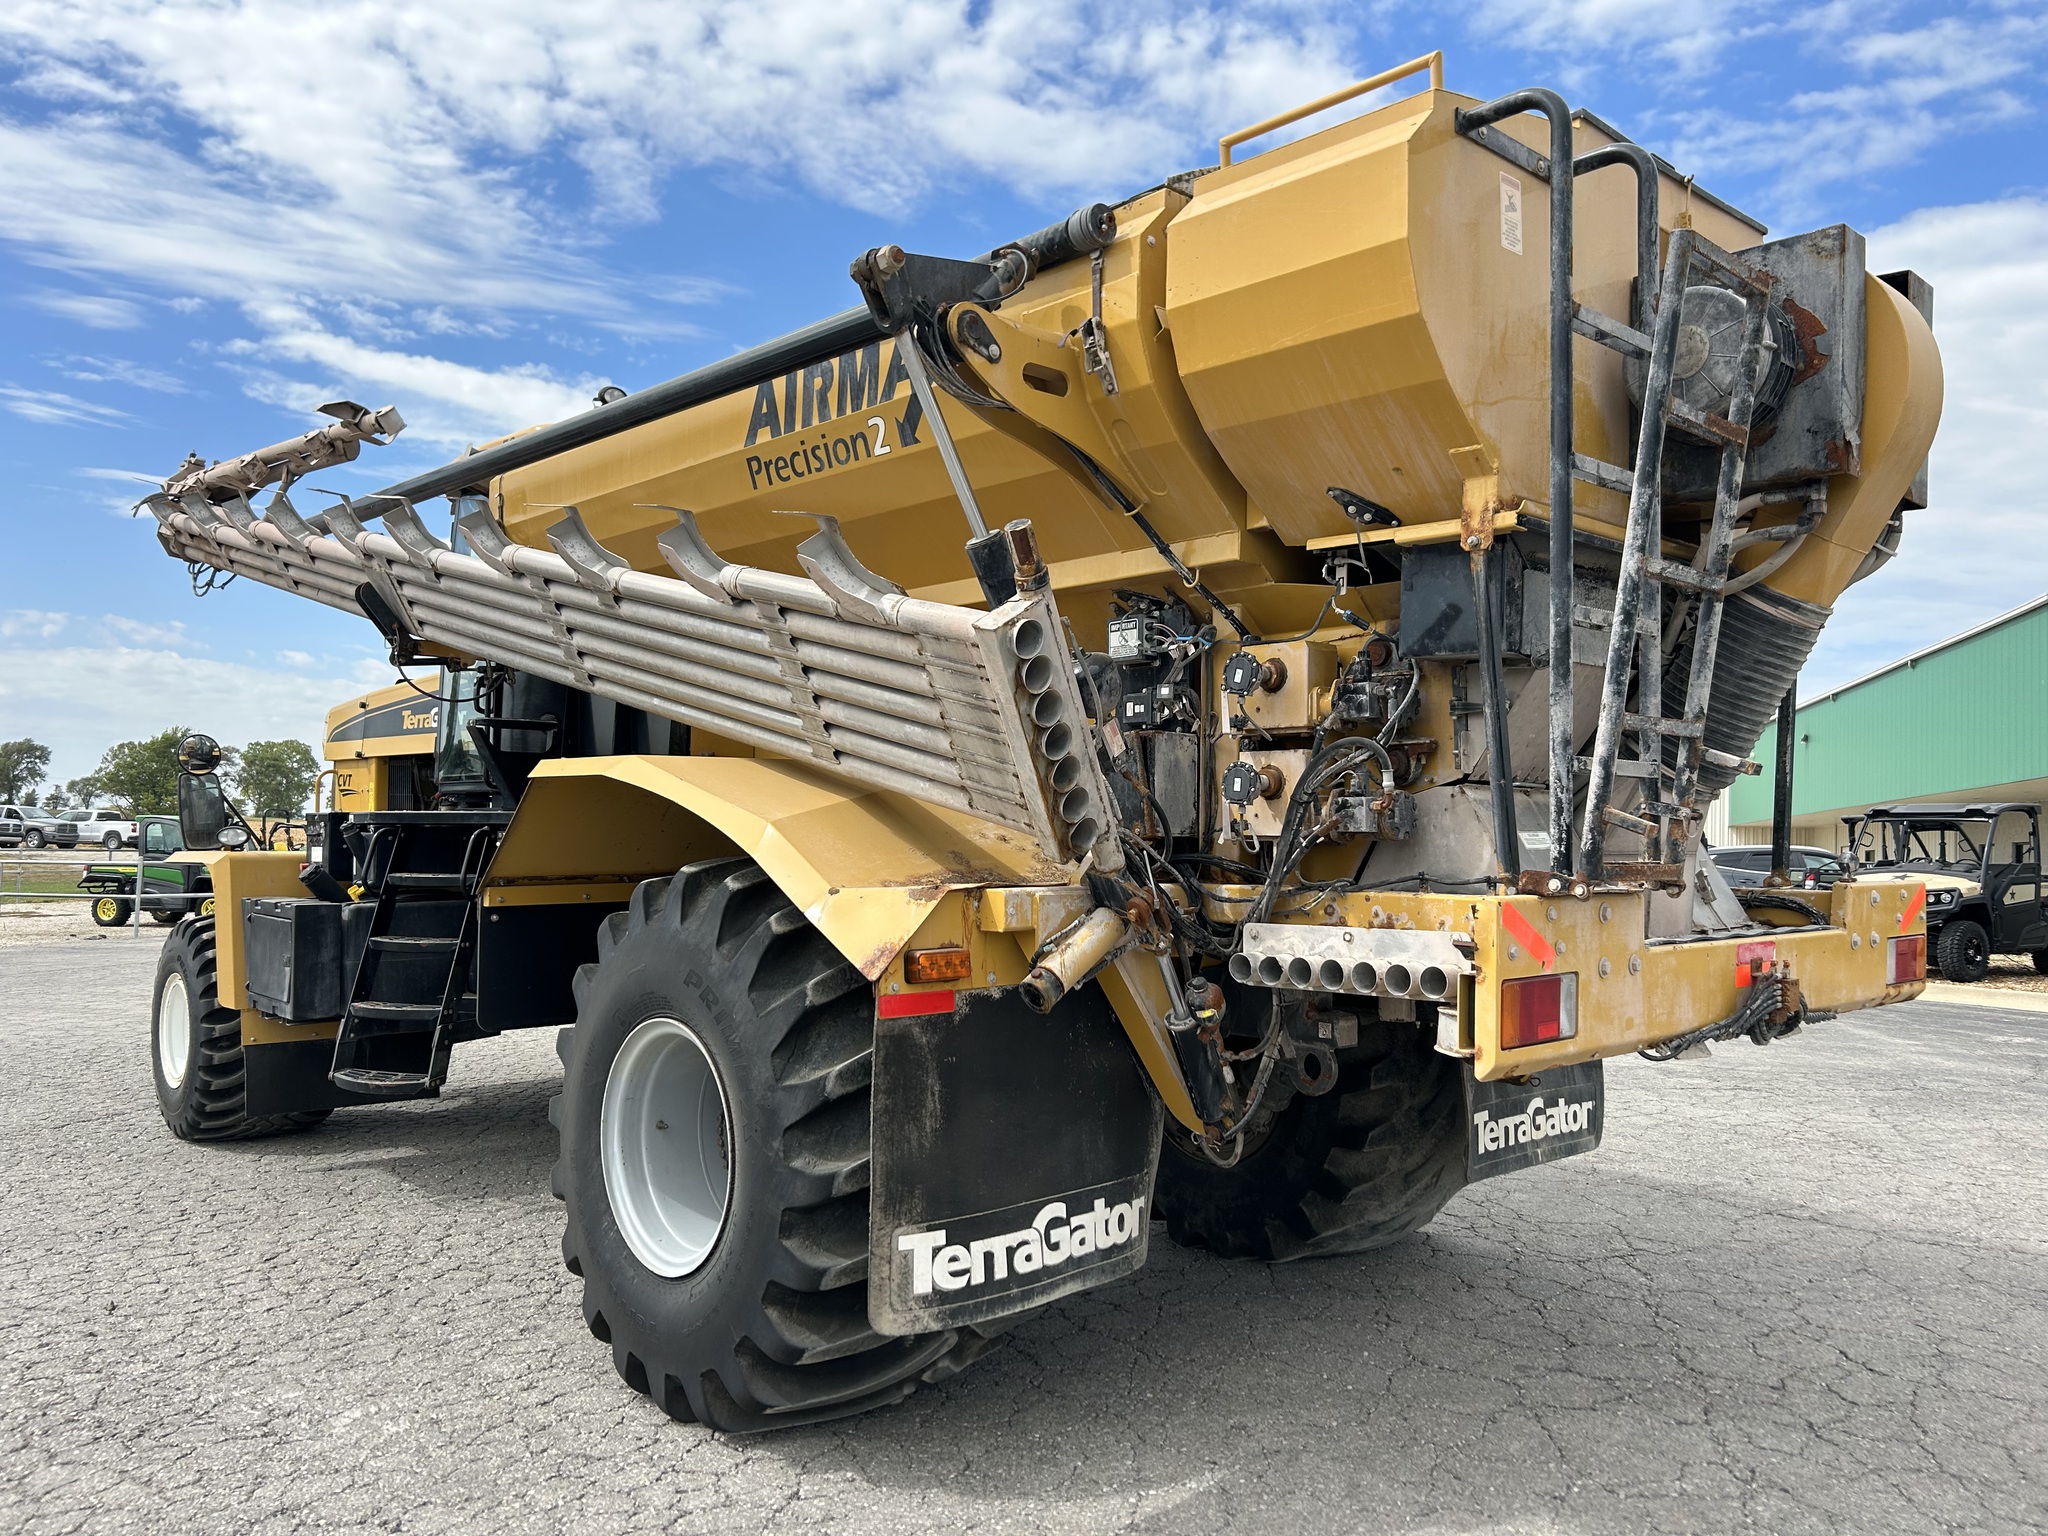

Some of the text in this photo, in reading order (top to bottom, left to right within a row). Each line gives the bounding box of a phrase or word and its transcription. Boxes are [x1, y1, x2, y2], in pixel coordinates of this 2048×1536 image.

[746, 416, 891, 490] Precision2
[1110, 621, 1137, 632] IMPRTANT
[338, 773, 352, 787] CVT
[1474, 1096, 1593, 1155] TerraGator
[898, 1197, 1145, 1296] TerraGator
